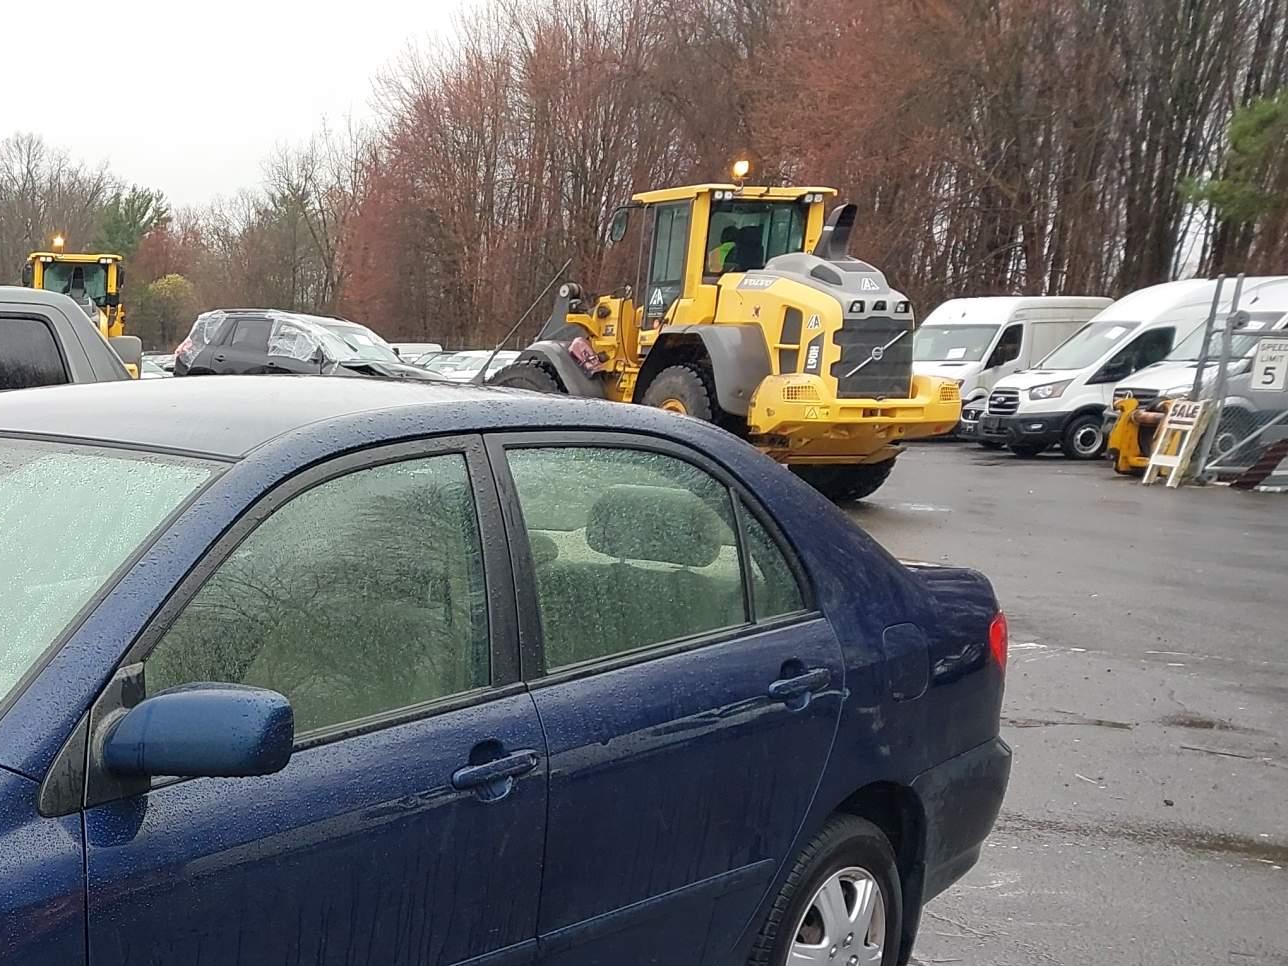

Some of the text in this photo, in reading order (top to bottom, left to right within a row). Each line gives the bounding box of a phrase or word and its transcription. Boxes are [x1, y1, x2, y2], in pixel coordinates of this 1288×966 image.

[806, 345, 820, 369] L90H
[1261, 366, 1276, 385] 5
[1169, 403, 1201, 419] SALE
